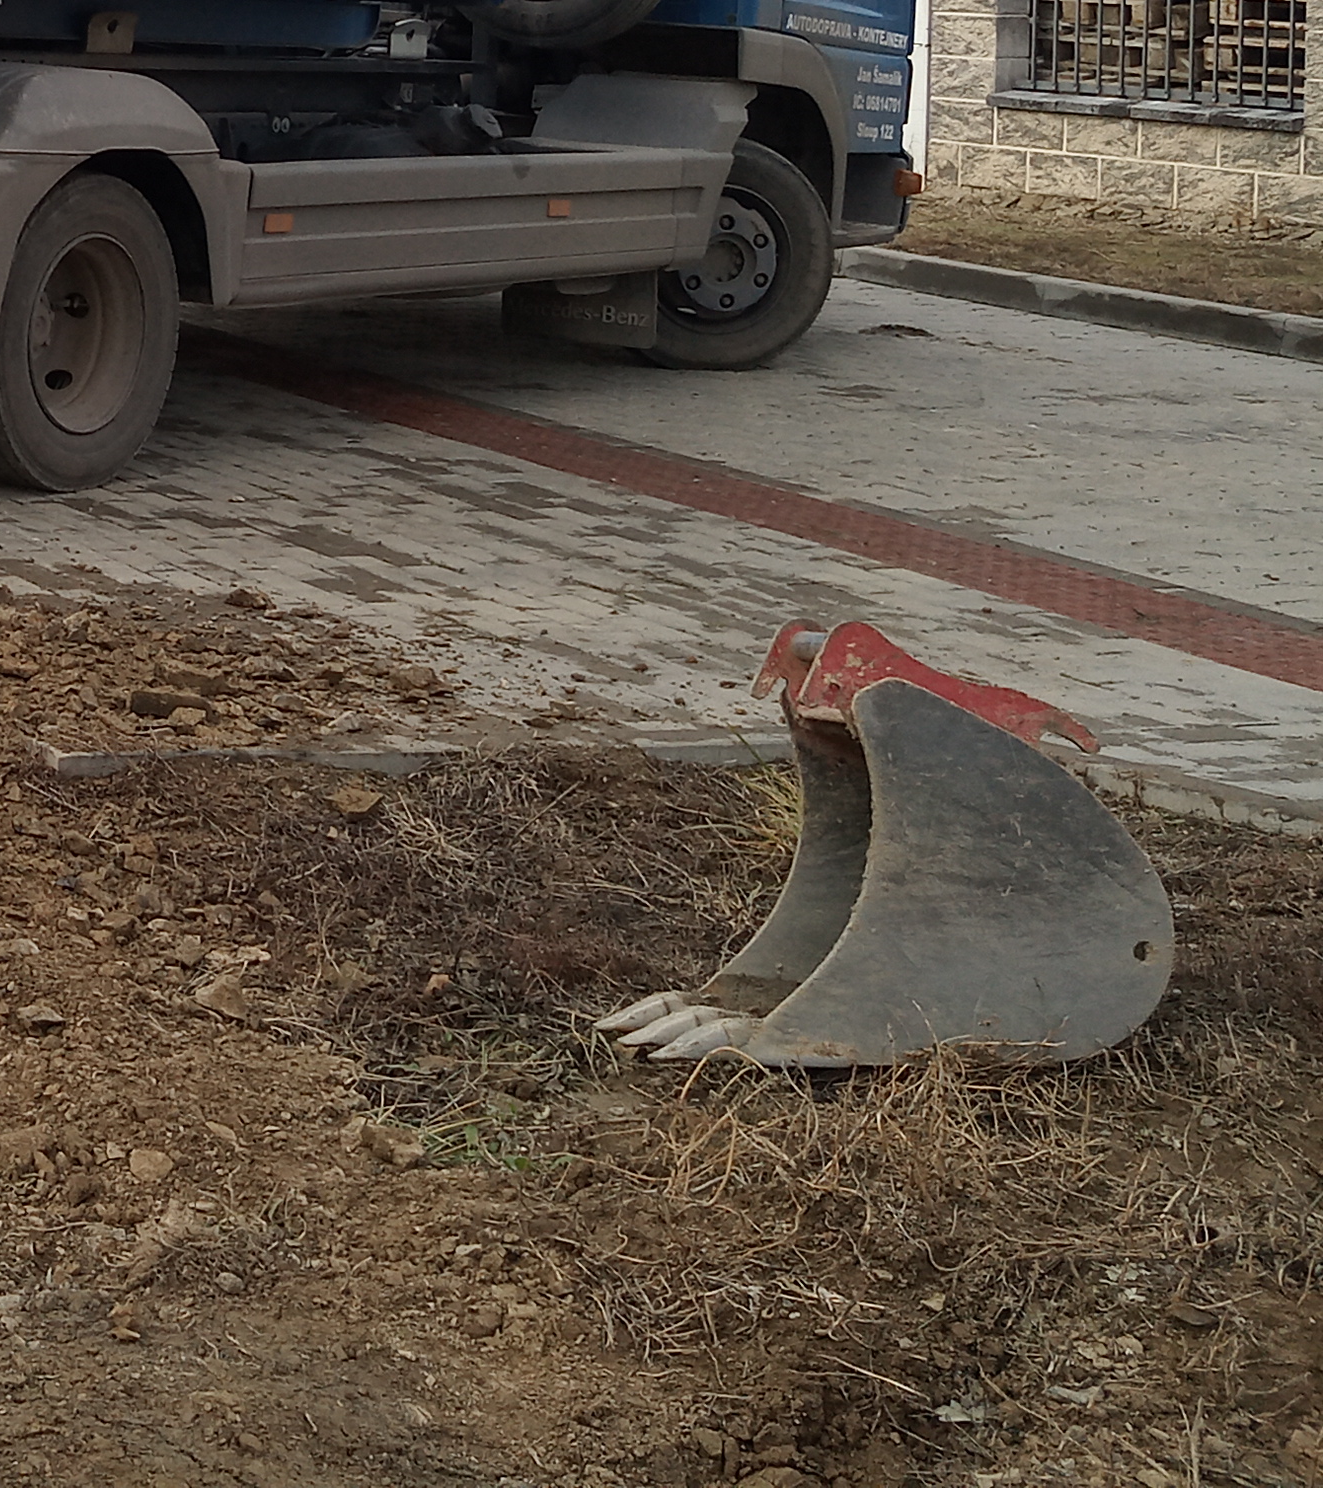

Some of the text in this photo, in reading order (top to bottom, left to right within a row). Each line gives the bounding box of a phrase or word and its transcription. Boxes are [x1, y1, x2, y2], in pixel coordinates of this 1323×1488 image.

[786, 14, 852, 40] AUTODOPRAVA
[857, 26, 909, 50] KONTEJNERY
[857, 66, 872, 83] Jan
[880, 123, 895, 140] 122
